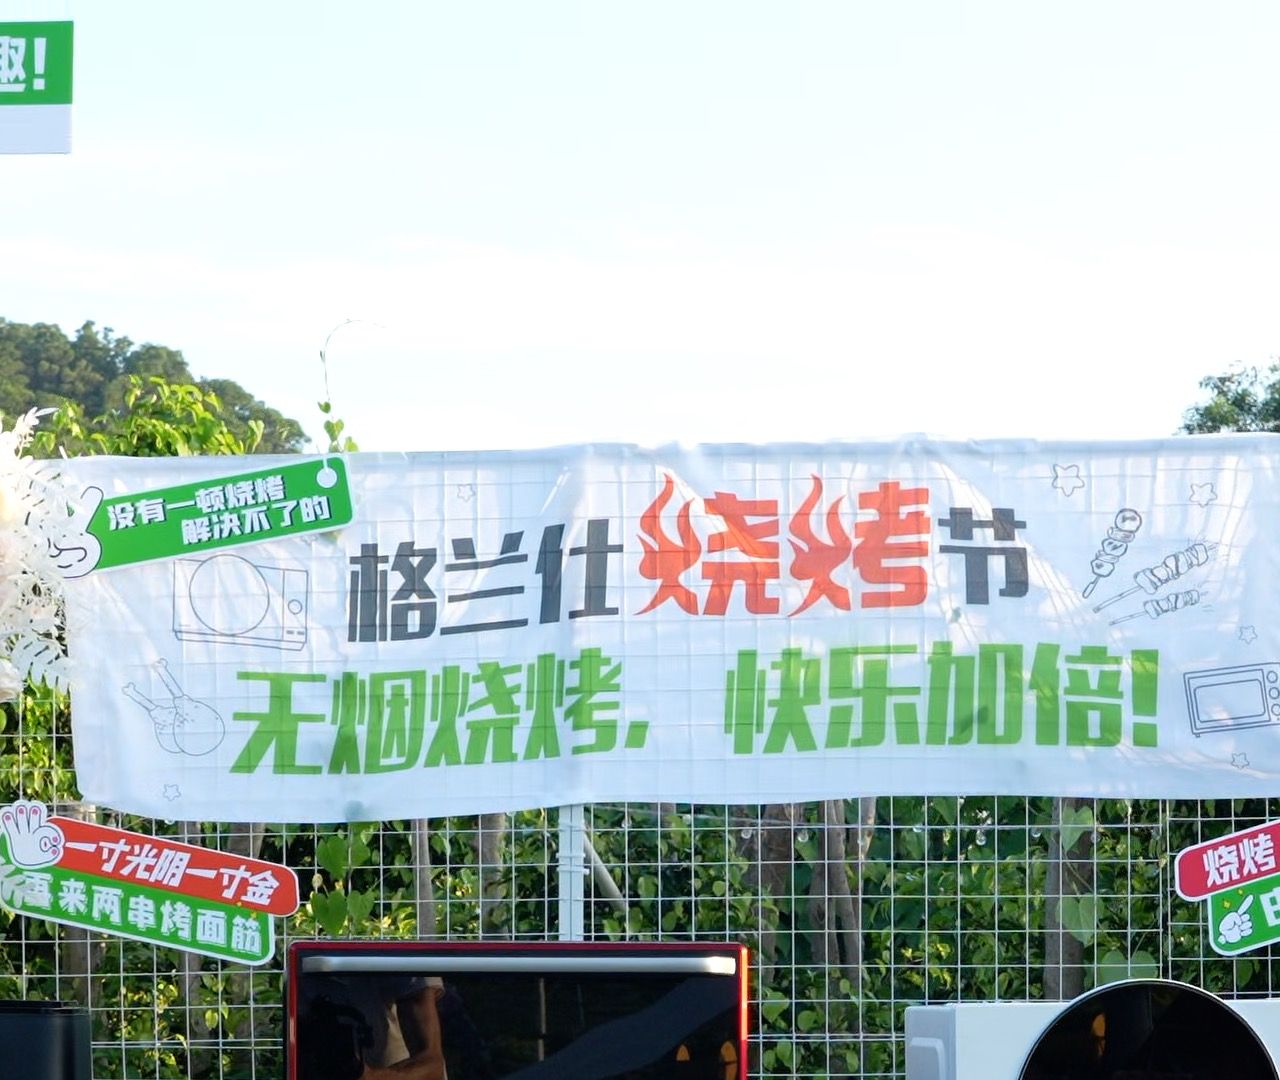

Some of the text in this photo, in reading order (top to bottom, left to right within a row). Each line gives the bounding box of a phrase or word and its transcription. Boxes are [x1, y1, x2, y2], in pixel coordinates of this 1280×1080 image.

[106, 475, 285, 531] 没有一顿烧烤
[181, 495, 331, 545] 解决不了的
[347, 467, 1030, 643] 格兰仕烧烤节
[64, 838, 280, 906] 一寸光阴一寸金
[1203, 834, 1276, 888] 烧烤
